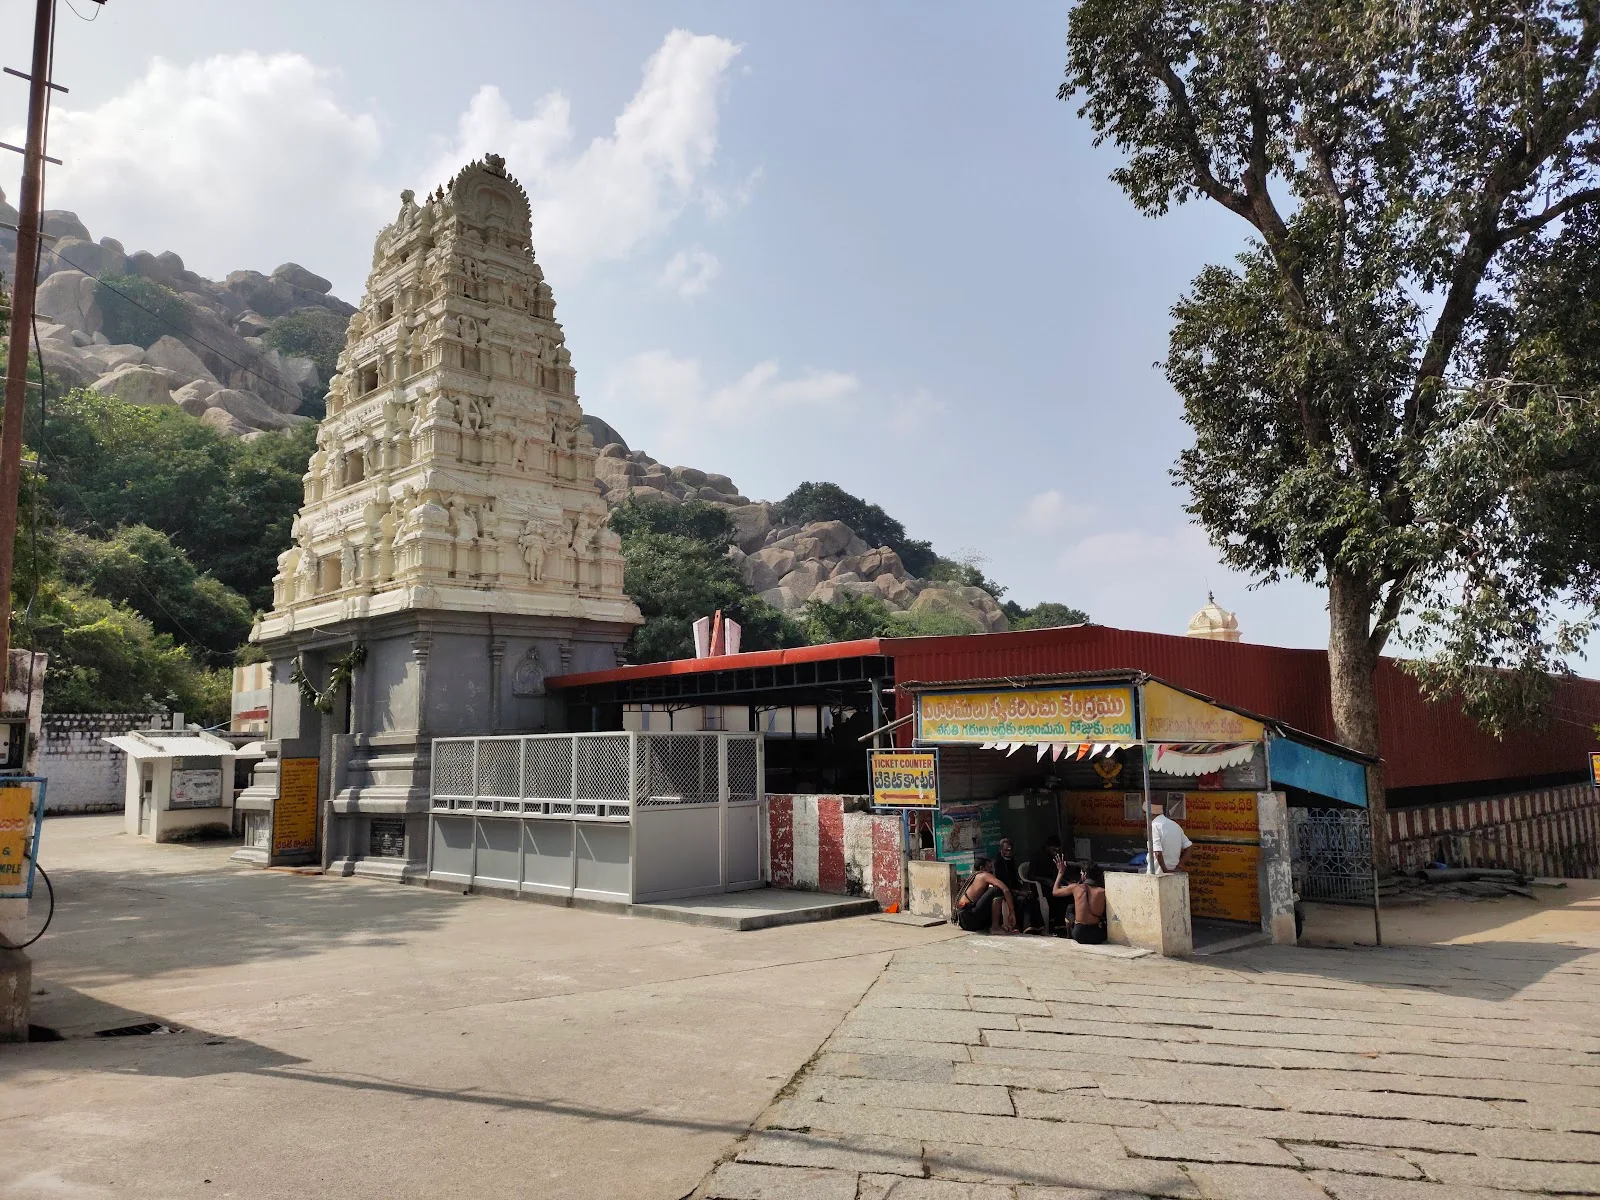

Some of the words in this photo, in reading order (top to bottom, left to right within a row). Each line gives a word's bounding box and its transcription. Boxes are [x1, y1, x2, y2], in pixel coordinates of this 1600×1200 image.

[874, 759, 898, 768] TICKET
[900, 759, 932, 768] COUNTER
[874, 771, 902, 789] టికెట్
